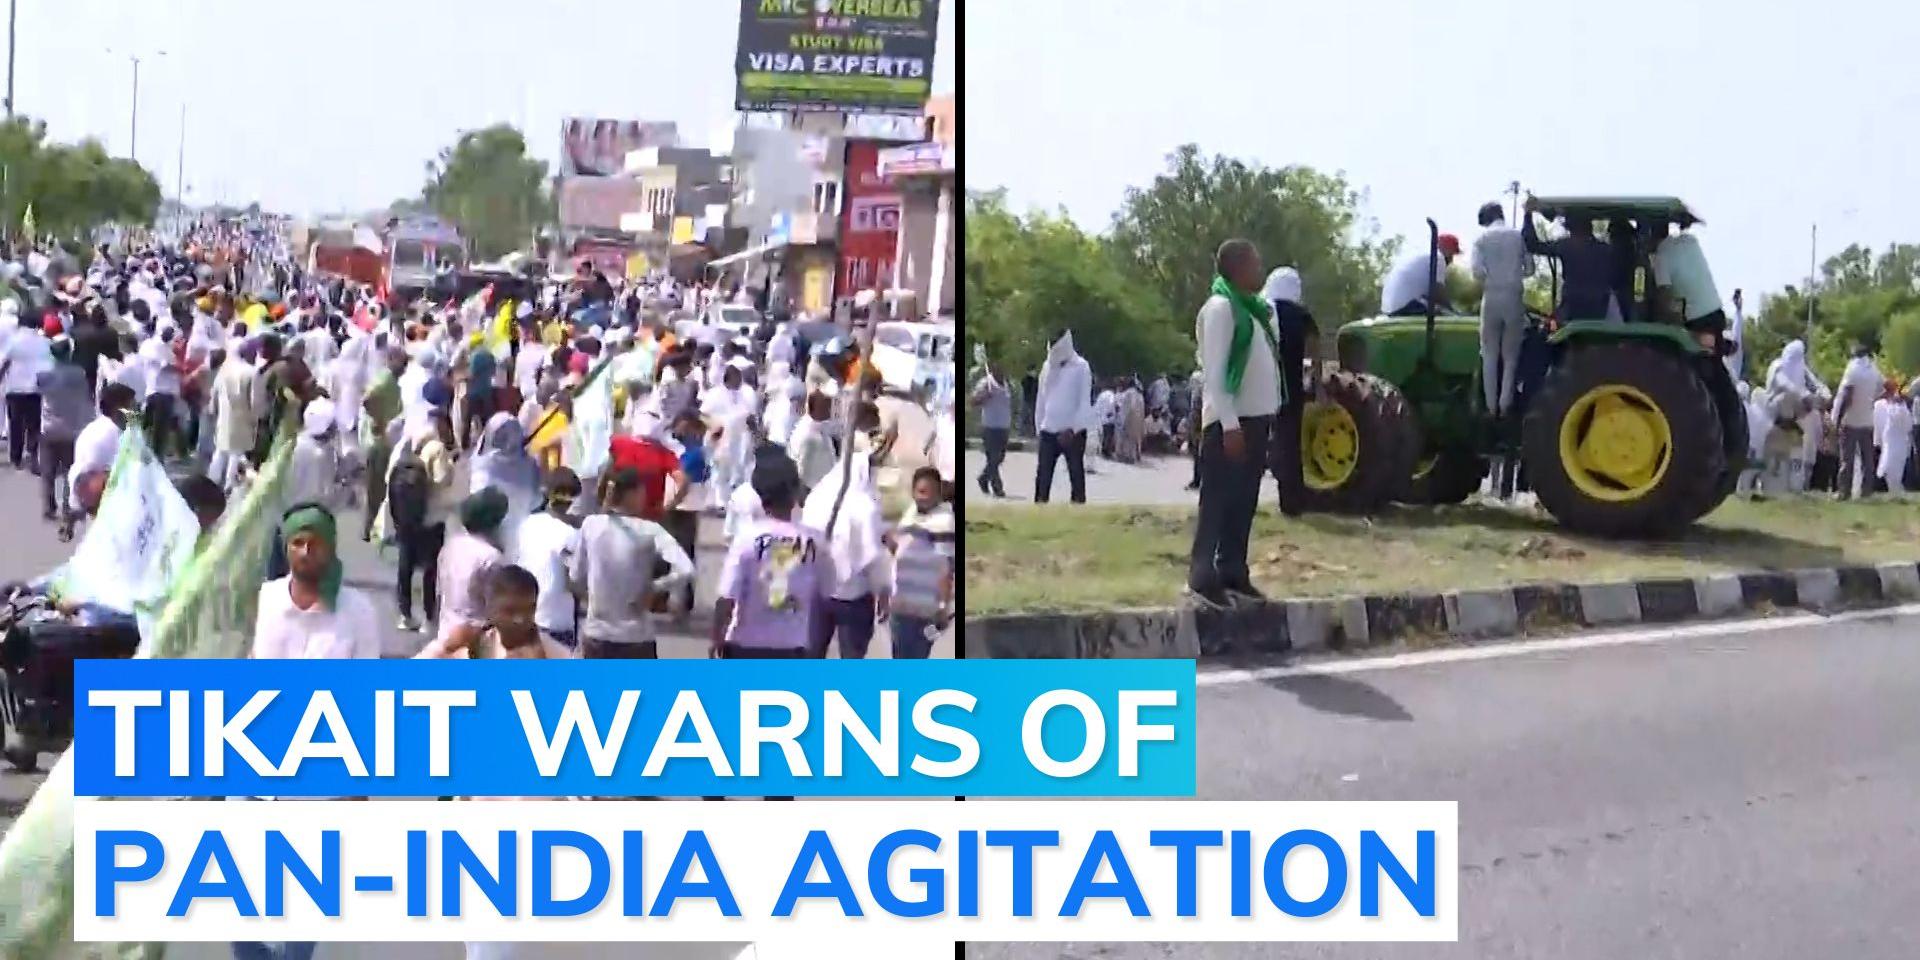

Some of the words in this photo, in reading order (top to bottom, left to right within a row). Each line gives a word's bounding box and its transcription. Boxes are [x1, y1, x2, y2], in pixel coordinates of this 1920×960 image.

[849, 36, 885, 51] VISA
[749, 53, 804, 71] VISA
[813, 54, 924, 77] EXPERTS
